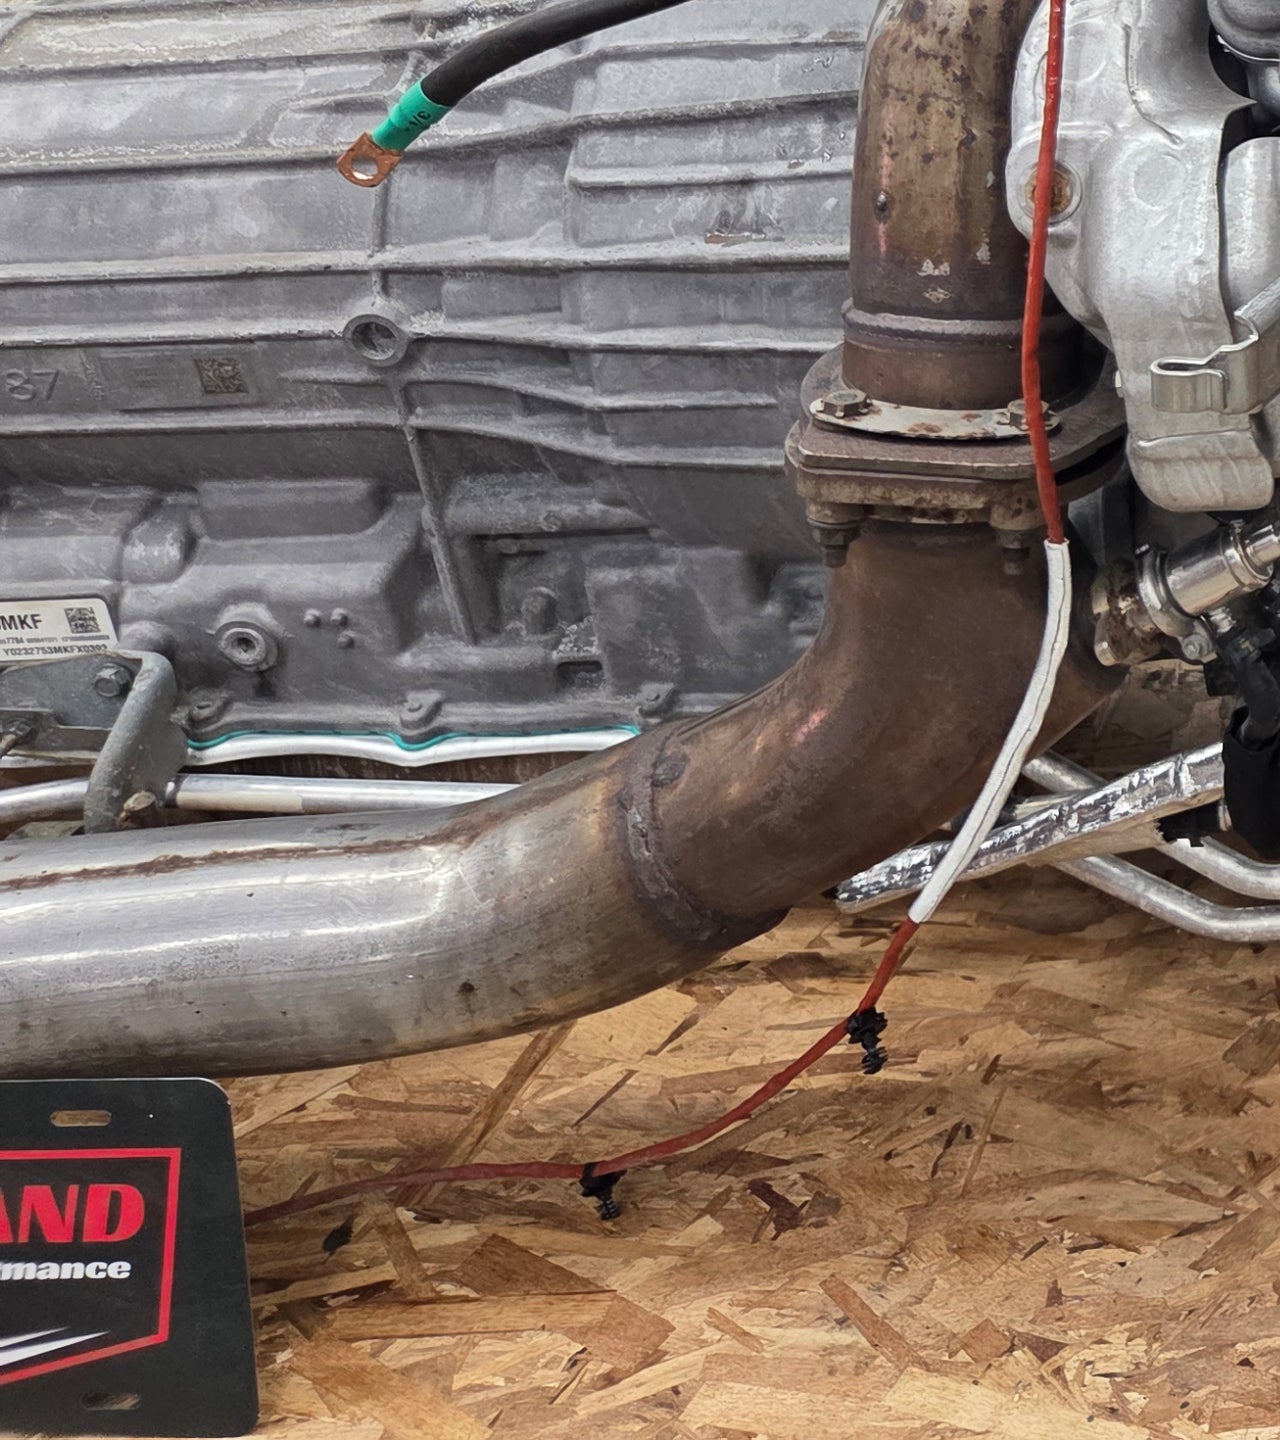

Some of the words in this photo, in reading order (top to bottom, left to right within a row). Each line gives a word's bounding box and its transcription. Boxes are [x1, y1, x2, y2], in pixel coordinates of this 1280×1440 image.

[0, 613, 42, 631] MKF
[0, 1183, 146, 1244] ND
[0, 1259, 132, 1281] mance
